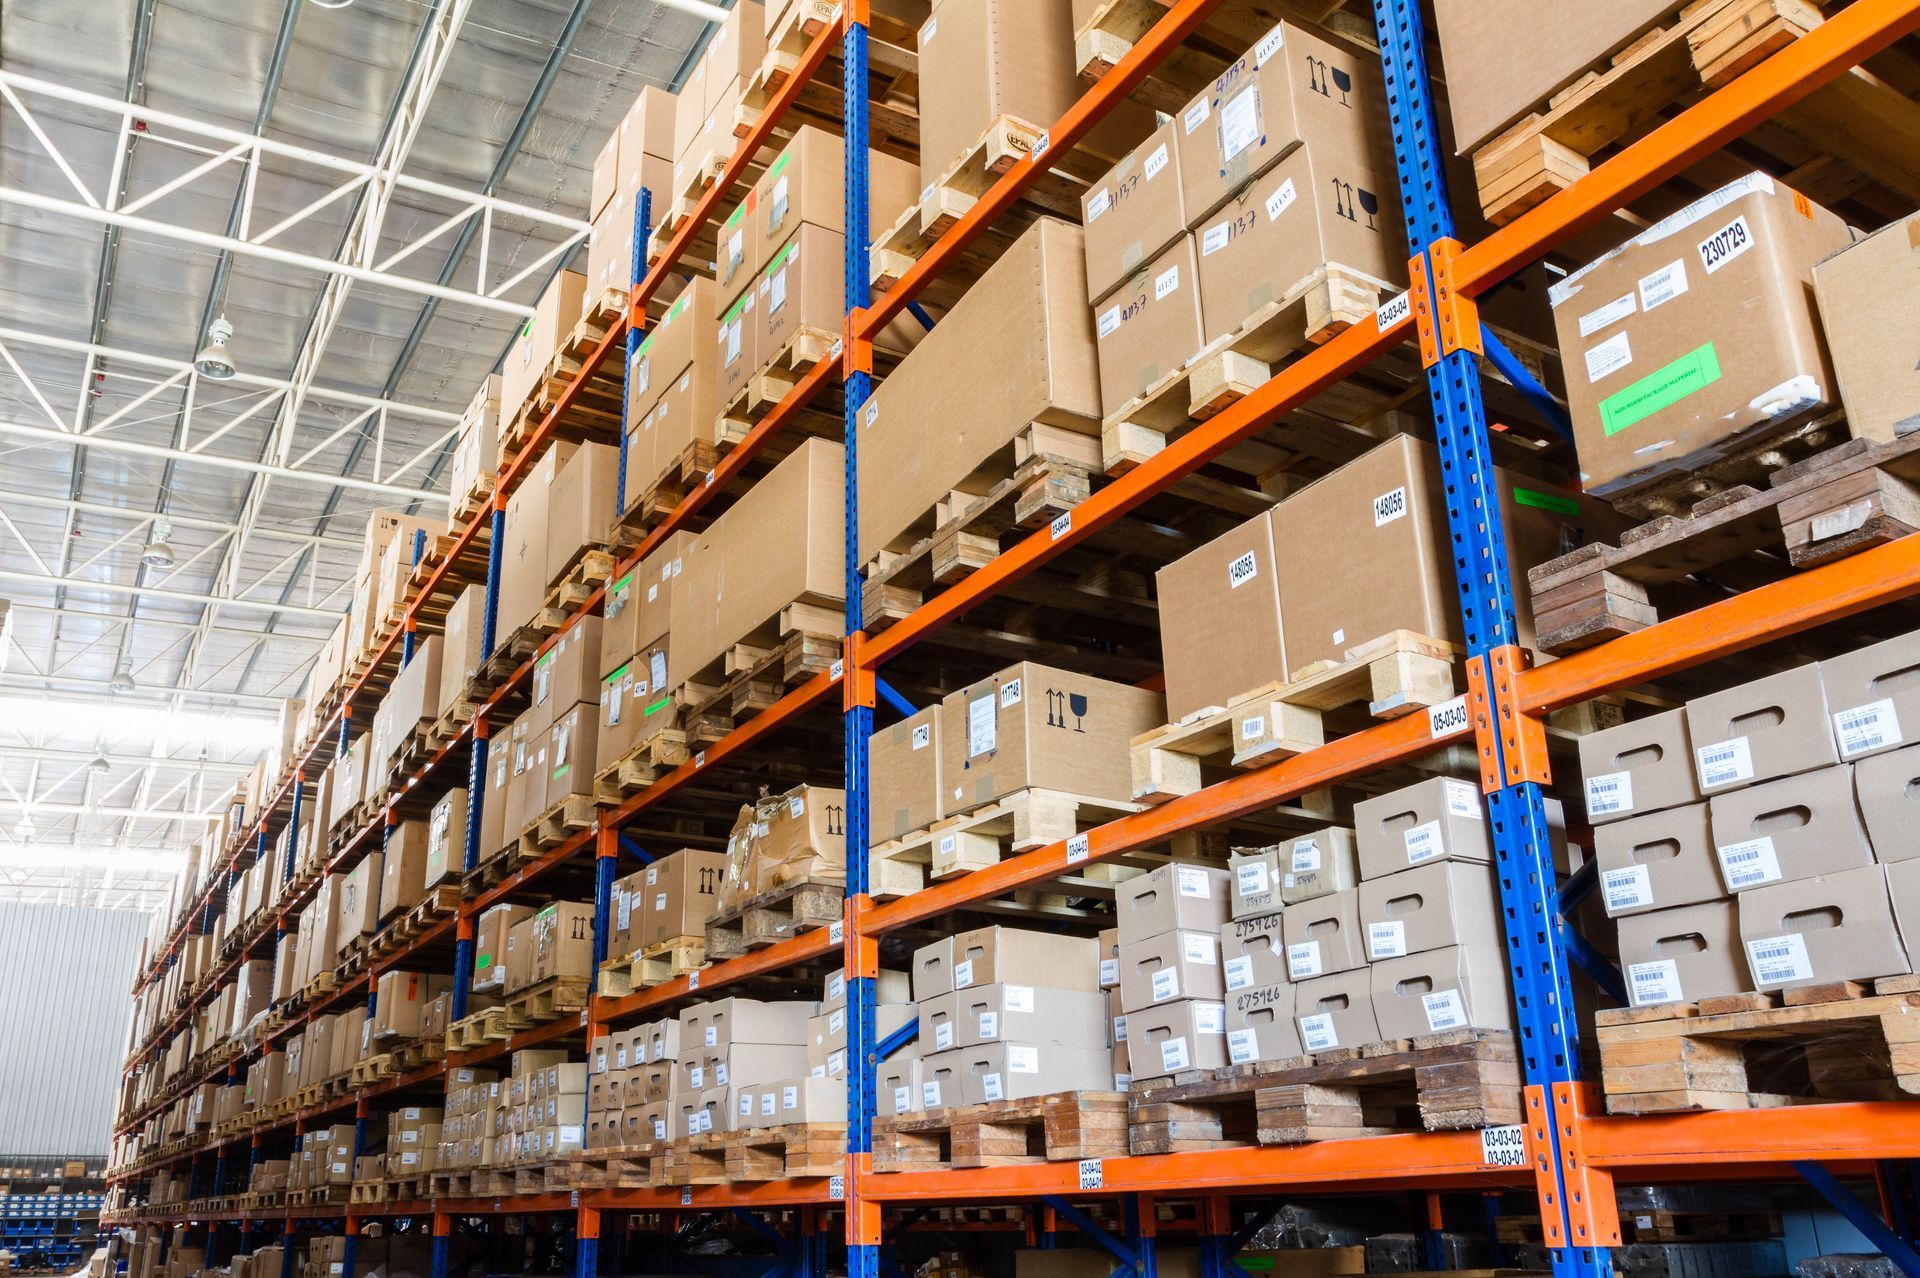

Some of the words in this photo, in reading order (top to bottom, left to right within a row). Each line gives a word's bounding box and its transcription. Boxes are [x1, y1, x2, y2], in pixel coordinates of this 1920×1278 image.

[1228, 210, 1256, 241] 1137
[1702, 222, 1746, 266] 230729
[1379, 298, 1407, 326] 03-03-04
[1669, 368, 1697, 386] MATERIAL
[1376, 491, 1403, 520] 148056
[1231, 555, 1253, 582] 148056
[1002, 682, 1019, 704] 117748
[1433, 705, 1466, 731] 05-03-03
[1069, 840, 1087, 856] 03-04-03
[1485, 1129, 1522, 1147] 03-03-02
[1081, 1161, 1101, 1175] 03-04-02
[1488, 1149, 1525, 1166] 03-03-01
[1082, 1176, 1102, 1189] 03-04-01
